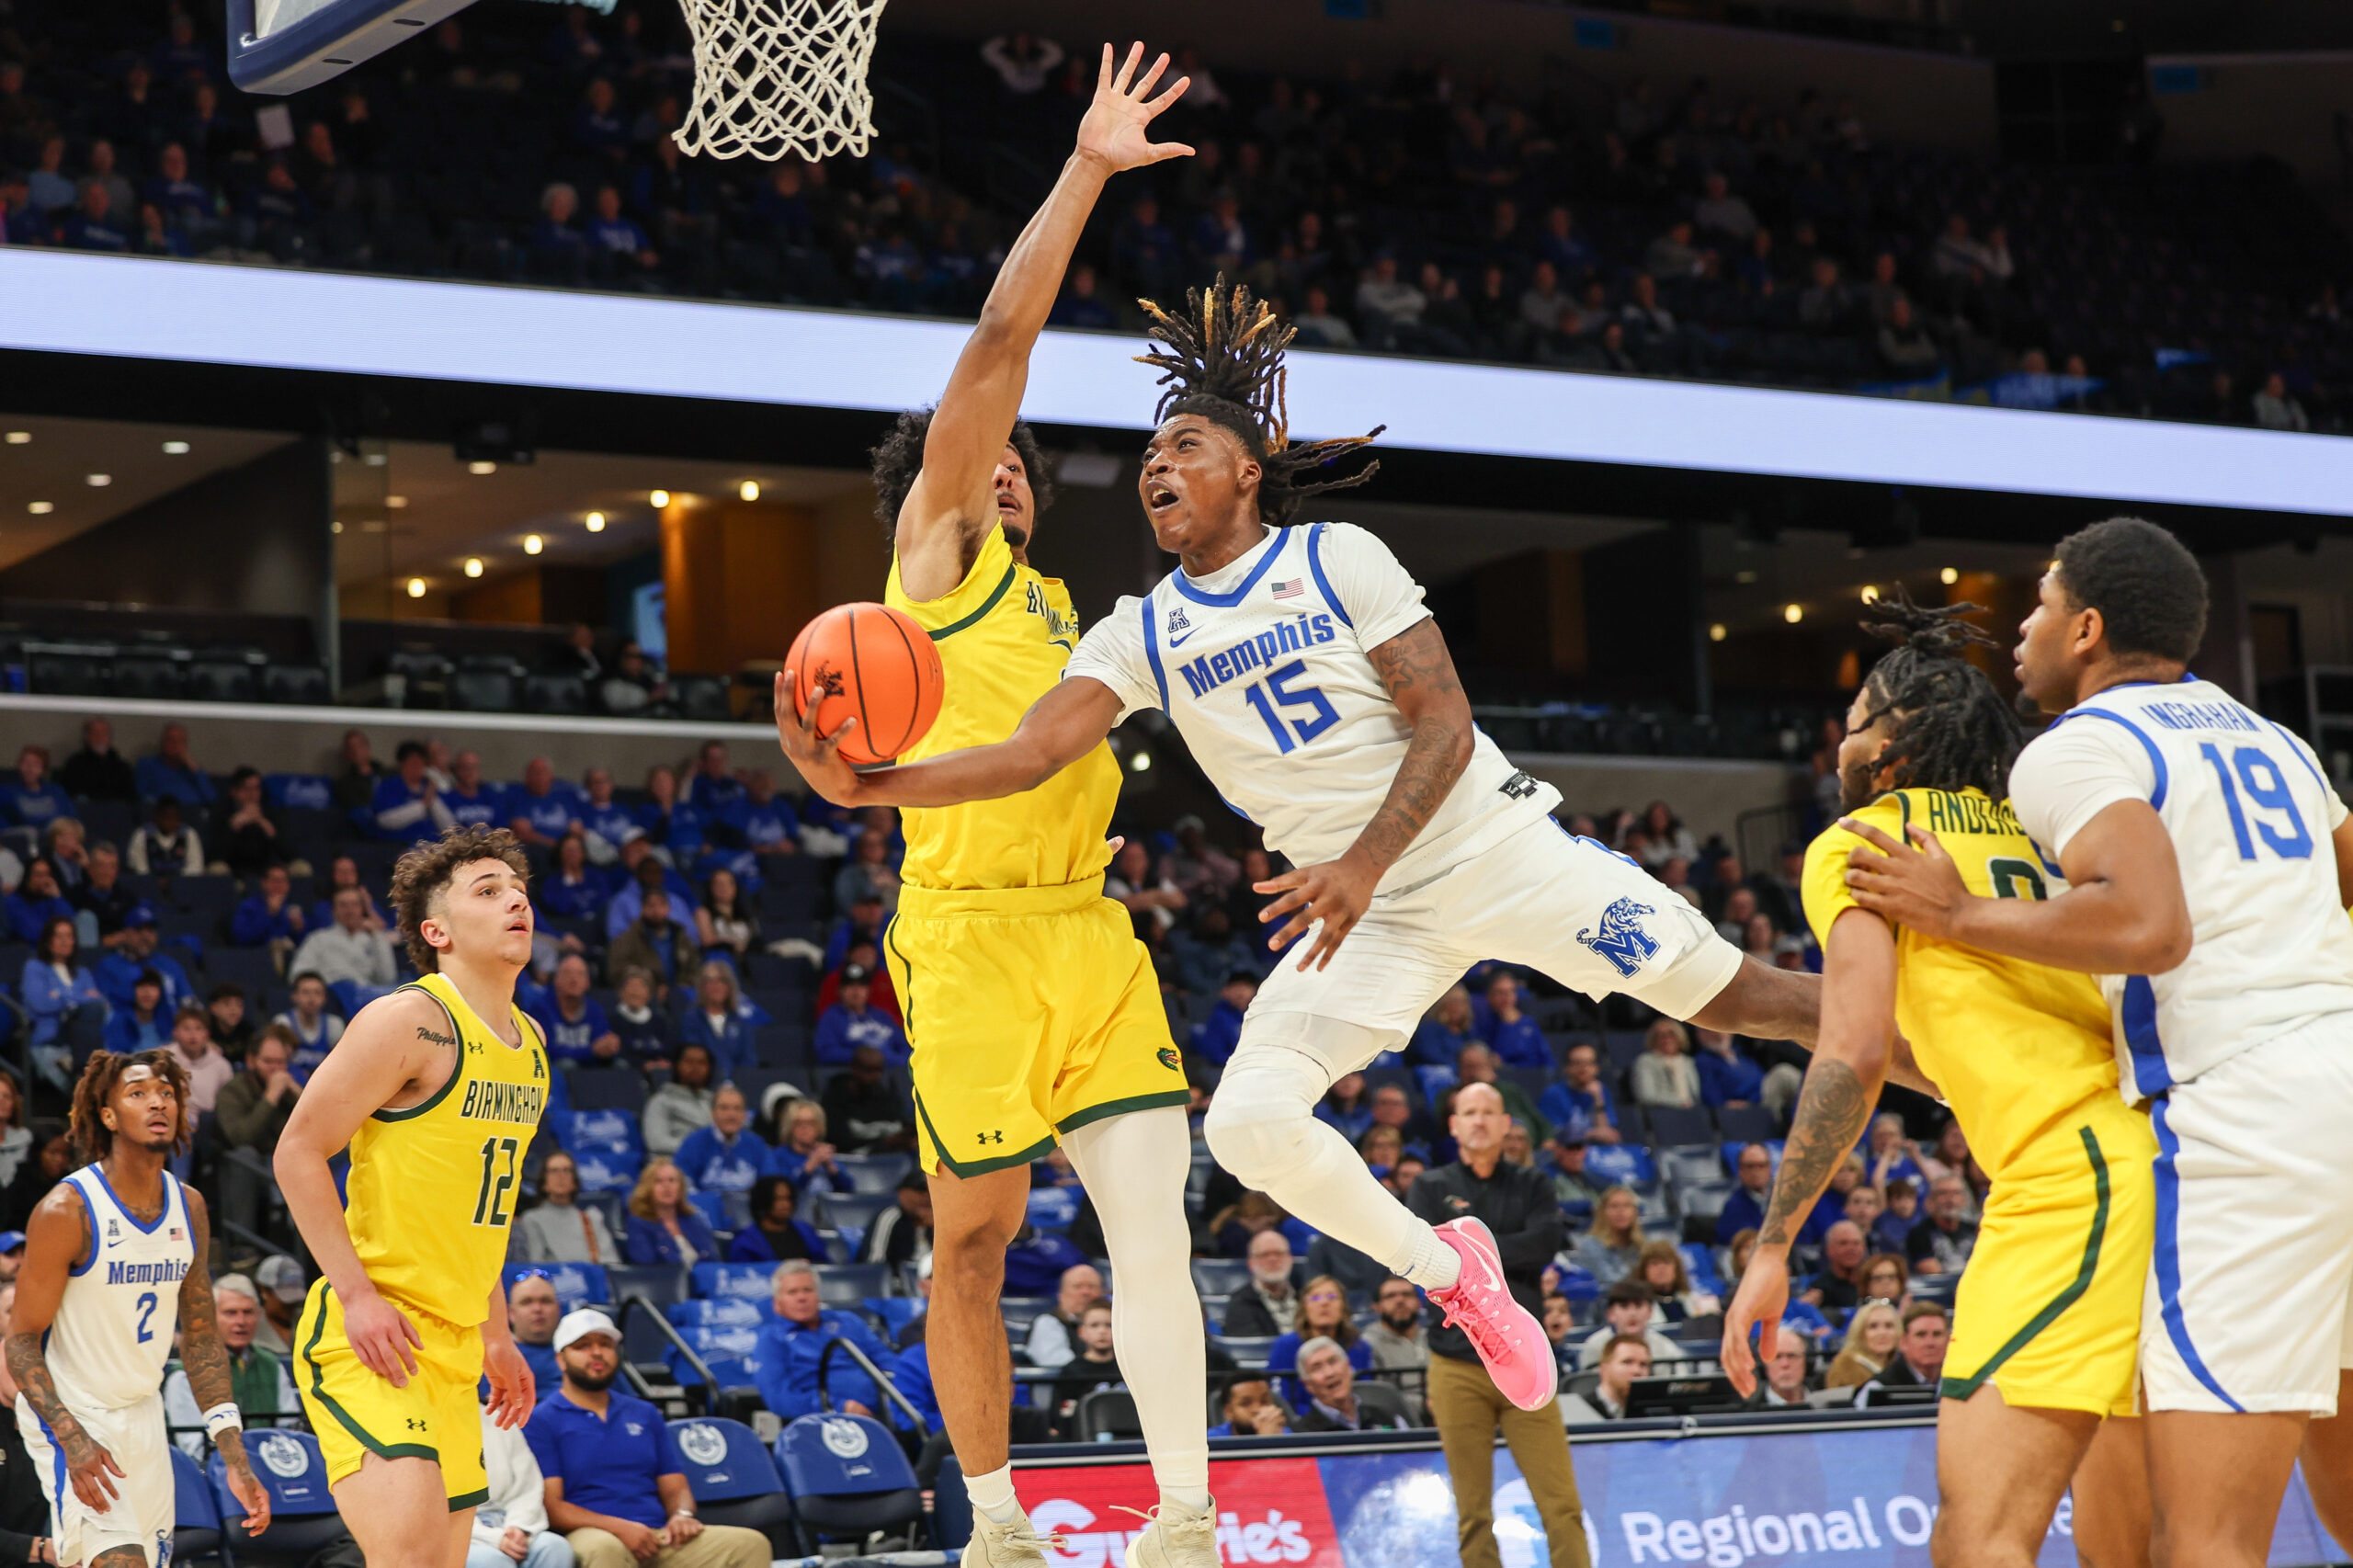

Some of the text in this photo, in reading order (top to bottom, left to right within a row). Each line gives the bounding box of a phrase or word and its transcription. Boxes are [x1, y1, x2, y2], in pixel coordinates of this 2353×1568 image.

[1176, 612, 1335, 699] Memphis
[1245, 658, 1343, 756] 15
[2140, 702, 2262, 733] INGRAHAM
[1927, 790, 2028, 836] ANDERS
[2198, 742, 2314, 860] 19
[472, 1136, 519, 1228] 12
[106, 1258, 189, 1286] Memphis
[137, 1292, 158, 1344] 2
[1620, 1496, 1882, 1568] Regional
